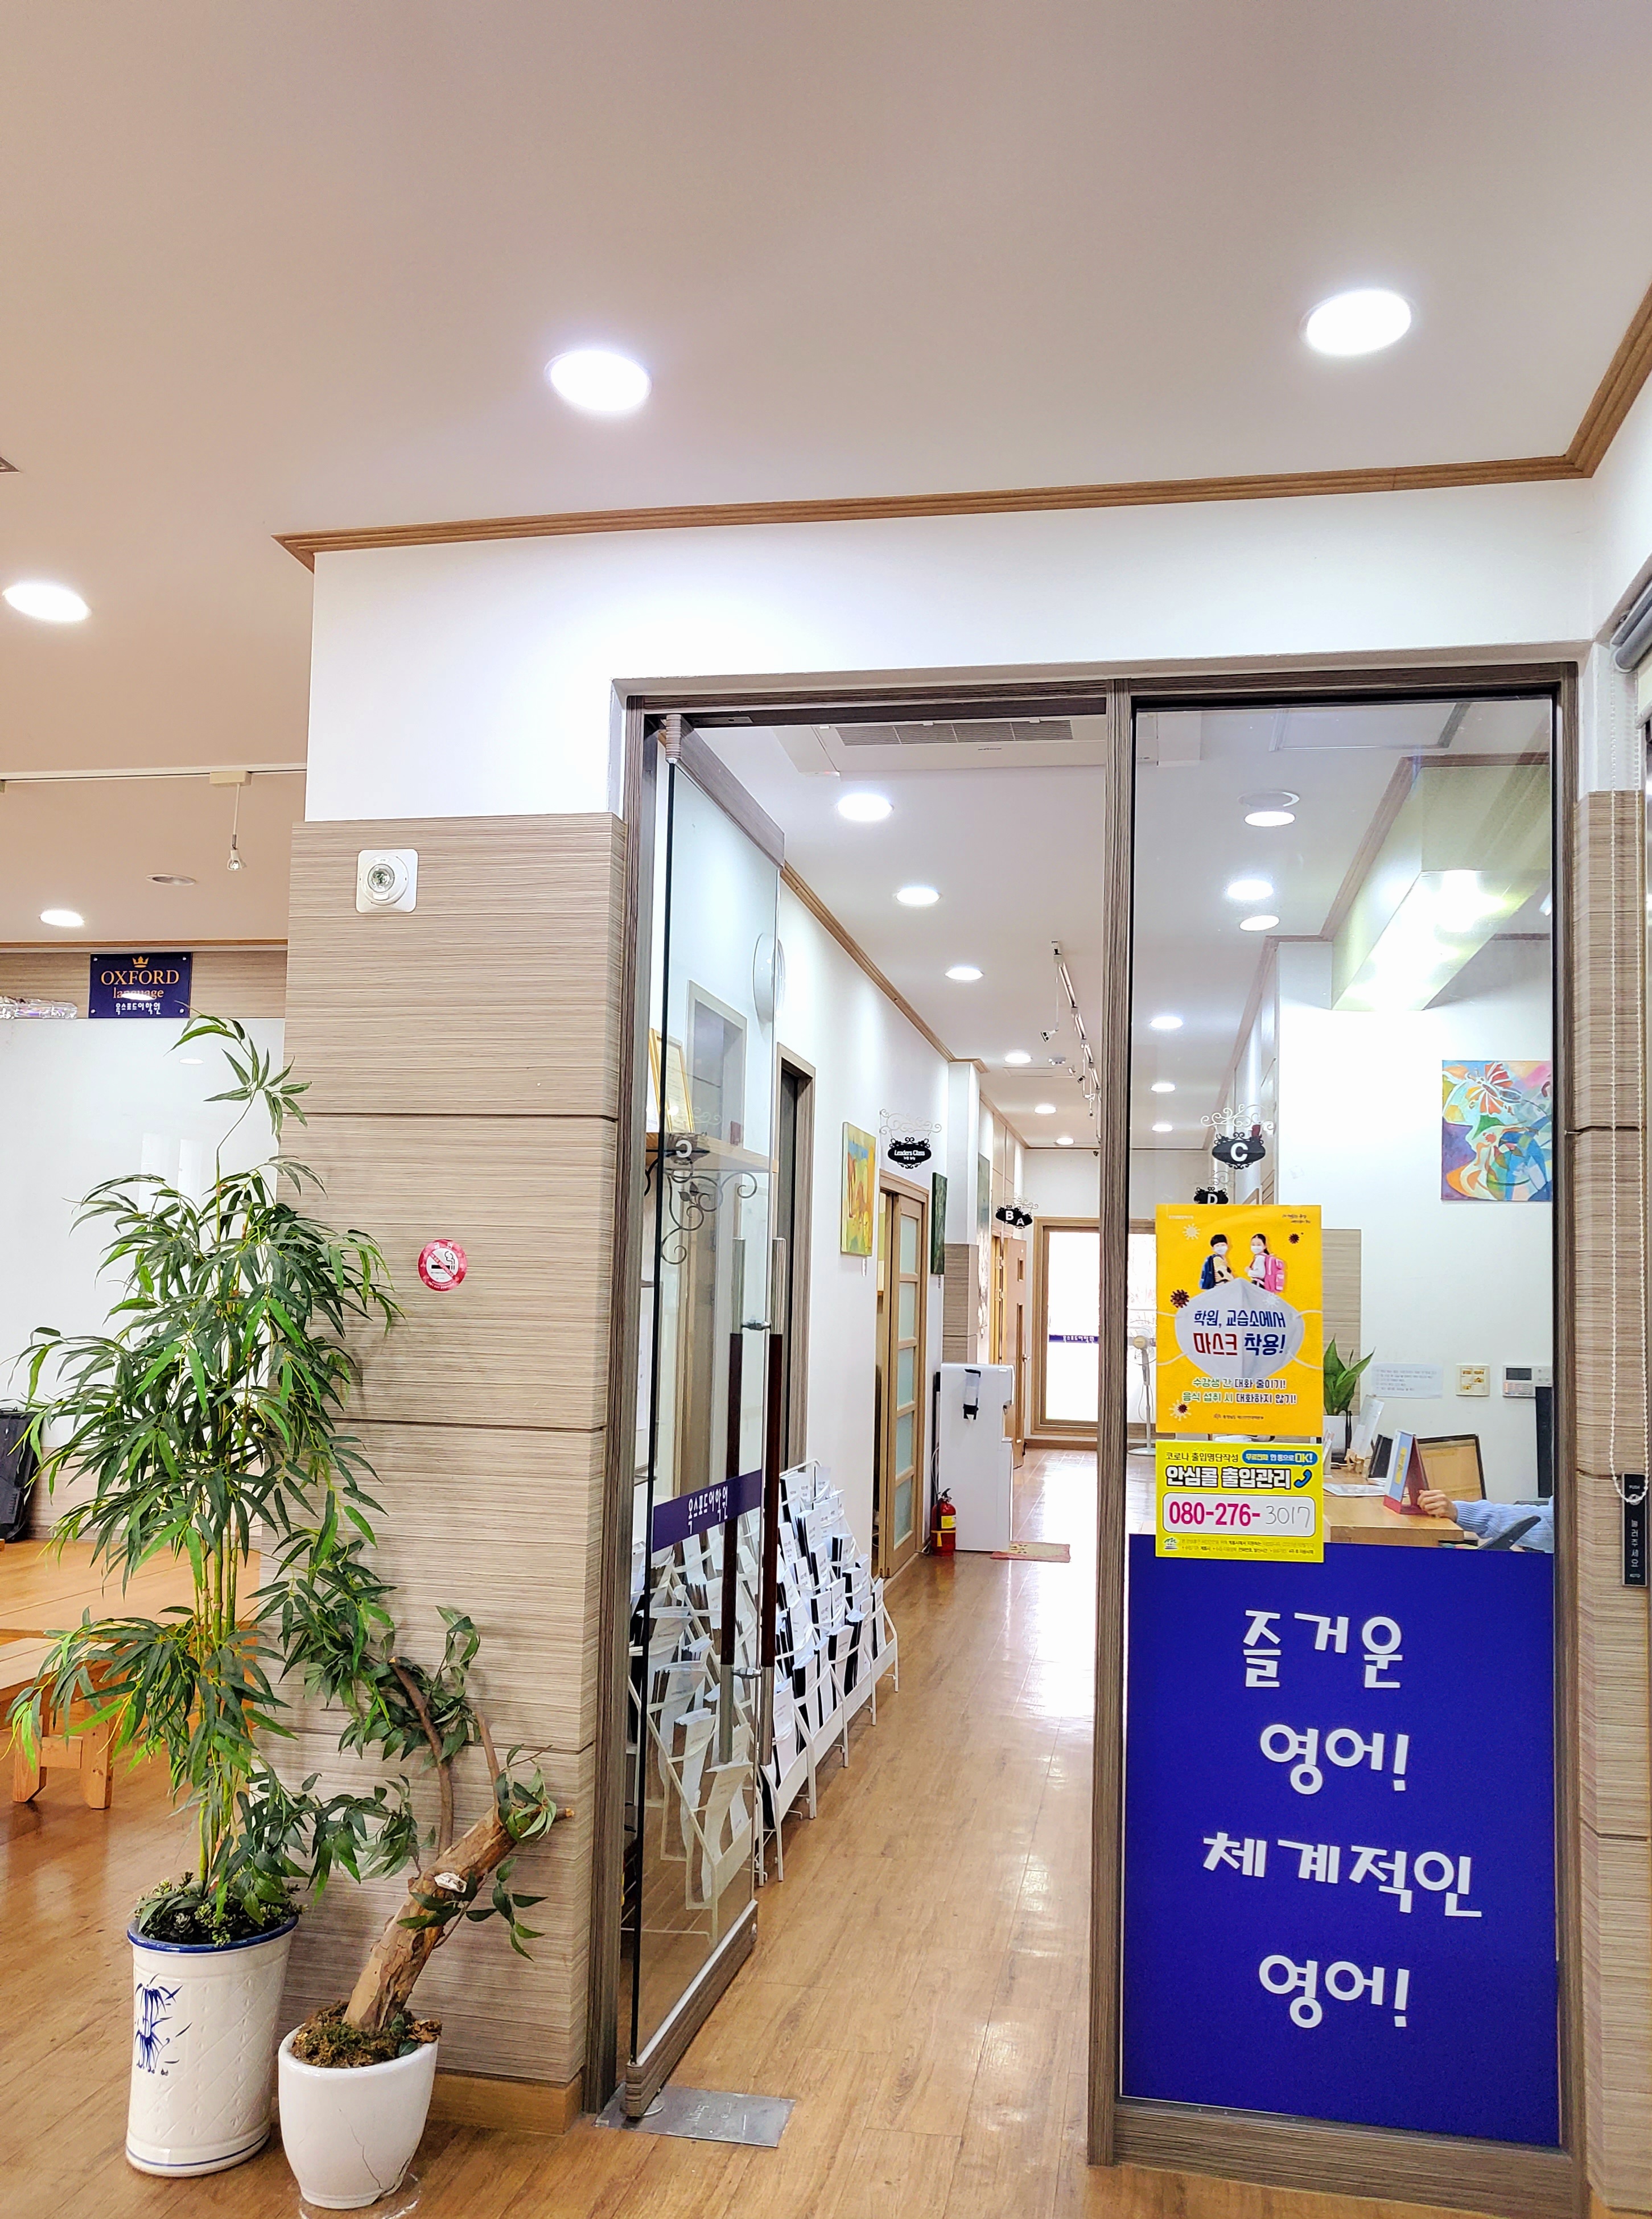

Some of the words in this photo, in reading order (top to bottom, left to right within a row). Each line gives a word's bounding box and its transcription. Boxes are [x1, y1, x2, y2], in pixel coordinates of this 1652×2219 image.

[101, 970, 179, 985] OXFORD
[116, 1002, 162, 1015] 옥스포드어학원
[1230, 1142, 1249, 1162] C
[1005, 1210, 1014, 1221] B
[1016, 1217, 1025, 1225] A
[1193, 1310, 1222, 1328] 학원,
[1226, 1309, 1286, 1328] 교습소에서
[1193, 1332, 1238, 1356] 마스크
[1244, 1333, 1286, 1357] 착용!
[1193, 1378, 1220, 1388] 수강생
[1222, 1378, 1231, 1388] 간
[1234, 1378, 1253, 1389] 대화
[1256, 1379, 1286, 1389] 줄이기!
[1183, 1392, 1200, 1402] 음식
[1204, 1393, 1221, 1402] 섭취
[1224, 1393, 1233, 1402] 시
[1236, 1393, 1272, 1403] 대화하지
[1275, 1394, 1297, 1403] 않기!
[1165, 1452, 1190, 1462] 코로나
[1192, 1452, 1239, 1463] 출입명단작성
[1295, 1453, 1313, 1463] OK!
[1165, 1465, 1218, 1487] 안심콜
[1221, 1466, 1291, 1489] 출입관리
[687, 1485, 728, 1535] 옥스포드어학원
[1265, 1505, 1311, 1528] 3017
[1243, 1609, 1403, 1689] 즐거운
[1260, 1723, 1410, 1795] 영어!
[1202, 1831, 1482, 1917] 체계적인
[1259, 1954, 1410, 2029] 영어!
